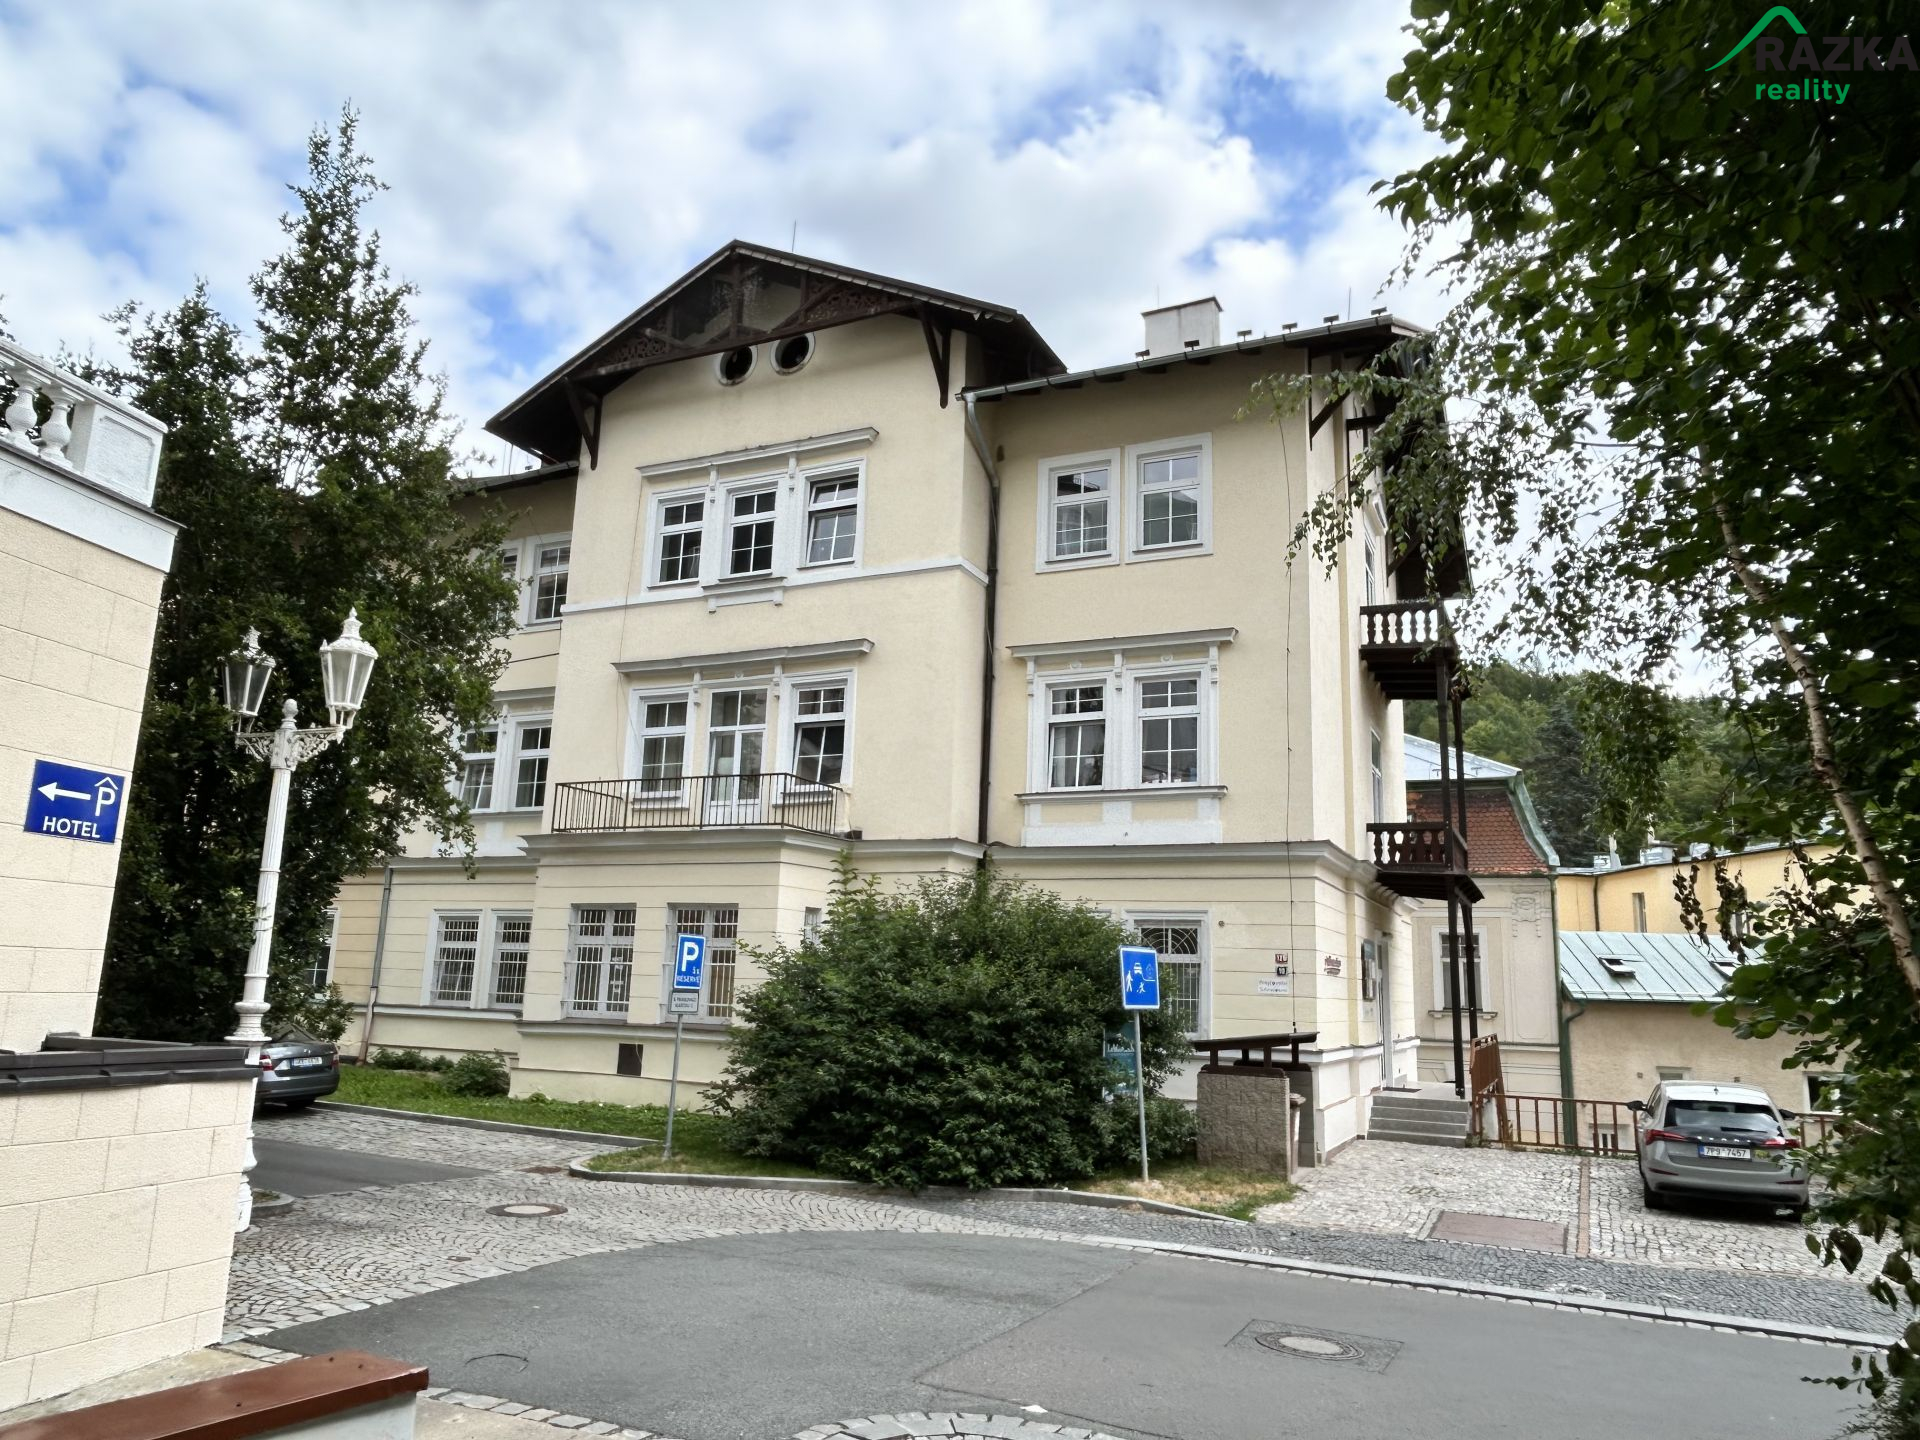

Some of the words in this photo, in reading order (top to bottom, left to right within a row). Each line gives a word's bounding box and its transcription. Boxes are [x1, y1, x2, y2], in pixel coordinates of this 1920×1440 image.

[95, 786, 116, 816] P
[43, 816, 100, 838] HOTEL
[681, 941, 699, 971] P
